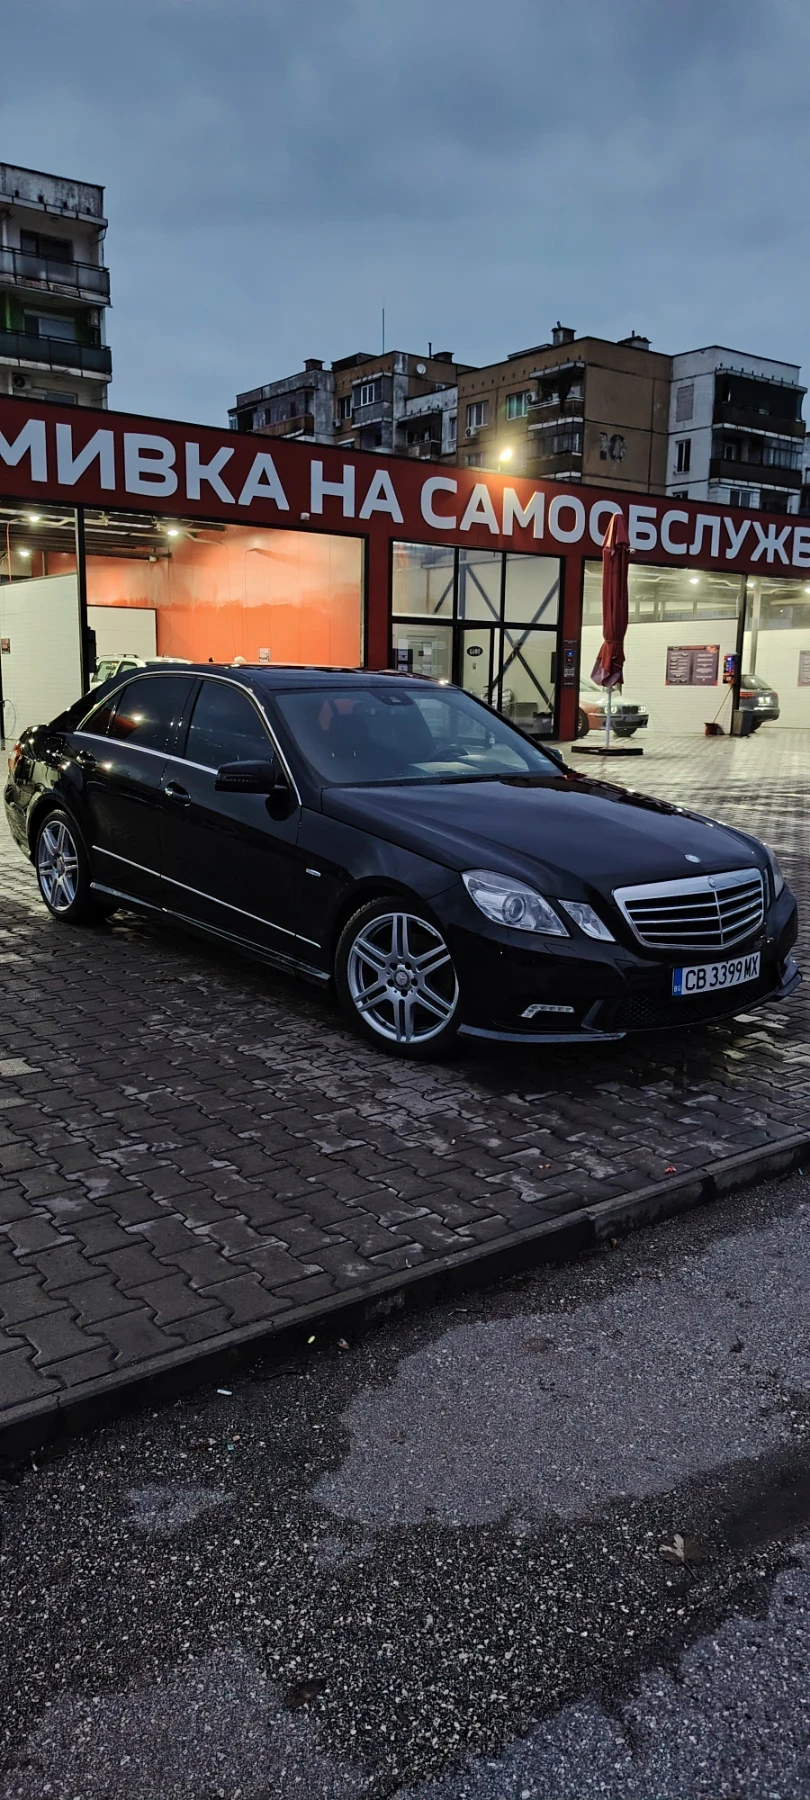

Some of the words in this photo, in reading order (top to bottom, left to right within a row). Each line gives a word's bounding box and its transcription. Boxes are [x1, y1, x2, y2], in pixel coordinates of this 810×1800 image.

[0, 418, 290, 511] МИВКА
[310, 460, 404, 524] НА
[685, 969, 707, 991] CB
[709, 960, 743, 987] 3399
[743, 955, 759, 979] MX
